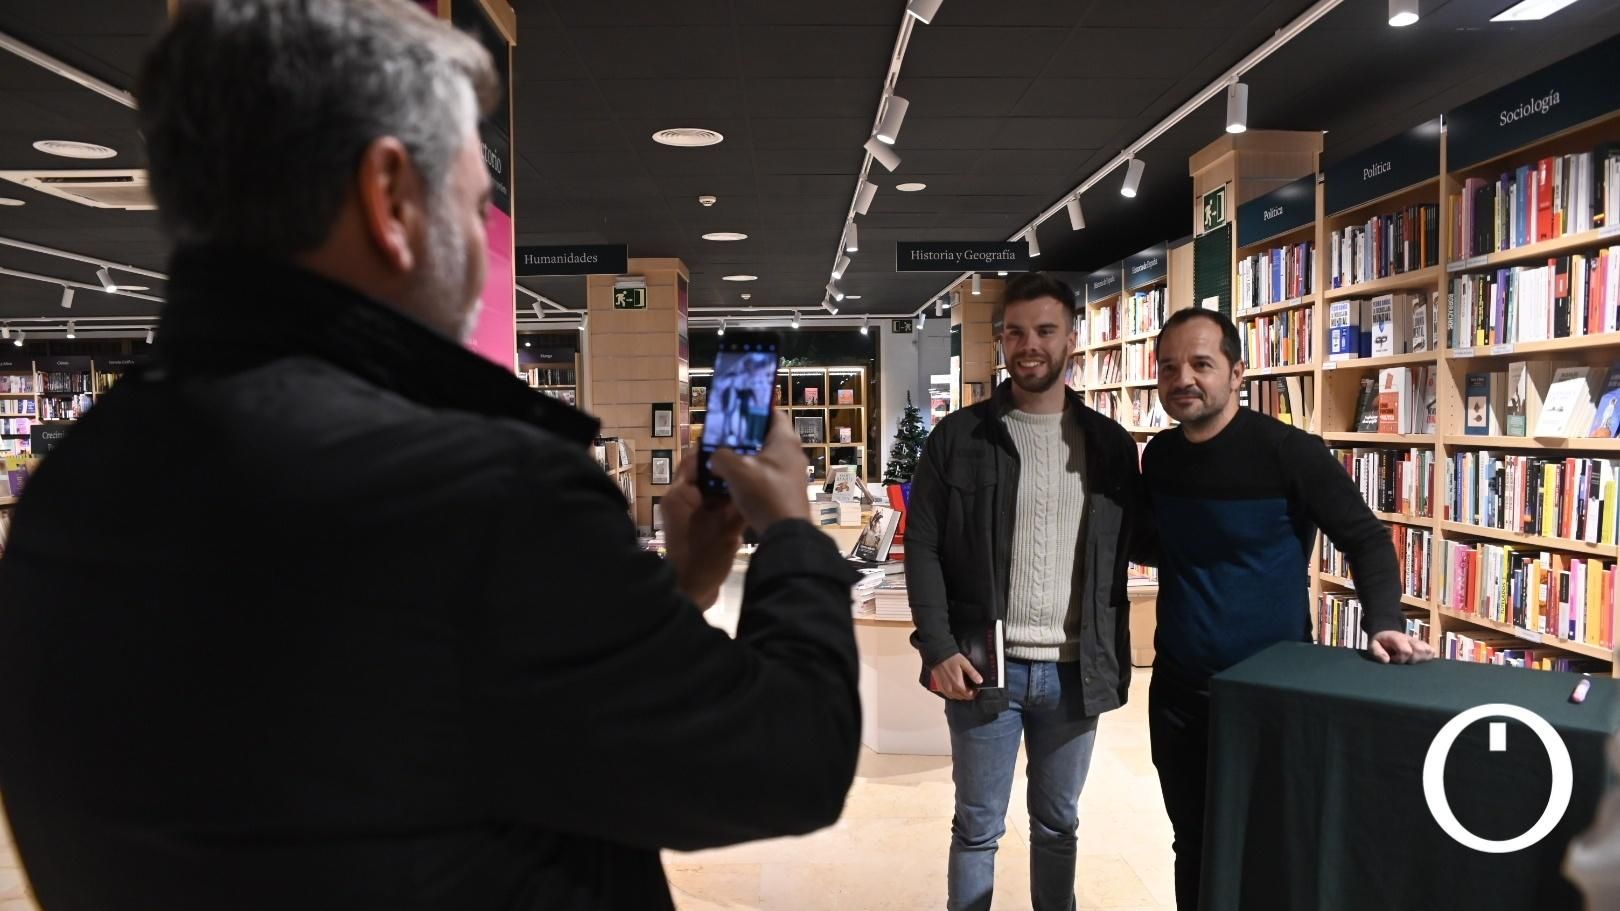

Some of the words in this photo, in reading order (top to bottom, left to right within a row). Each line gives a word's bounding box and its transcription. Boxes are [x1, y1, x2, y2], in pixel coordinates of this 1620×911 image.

[1499, 88, 1560, 126] Sociología
[1363, 160, 1392, 181] Política
[1263, 205, 1283, 221] Política
[524, 252, 598, 265] Humanidades
[911, 249, 954, 261] Historia
[955, 252, 962, 264] y
[964, 249, 1016, 263] Geografía
